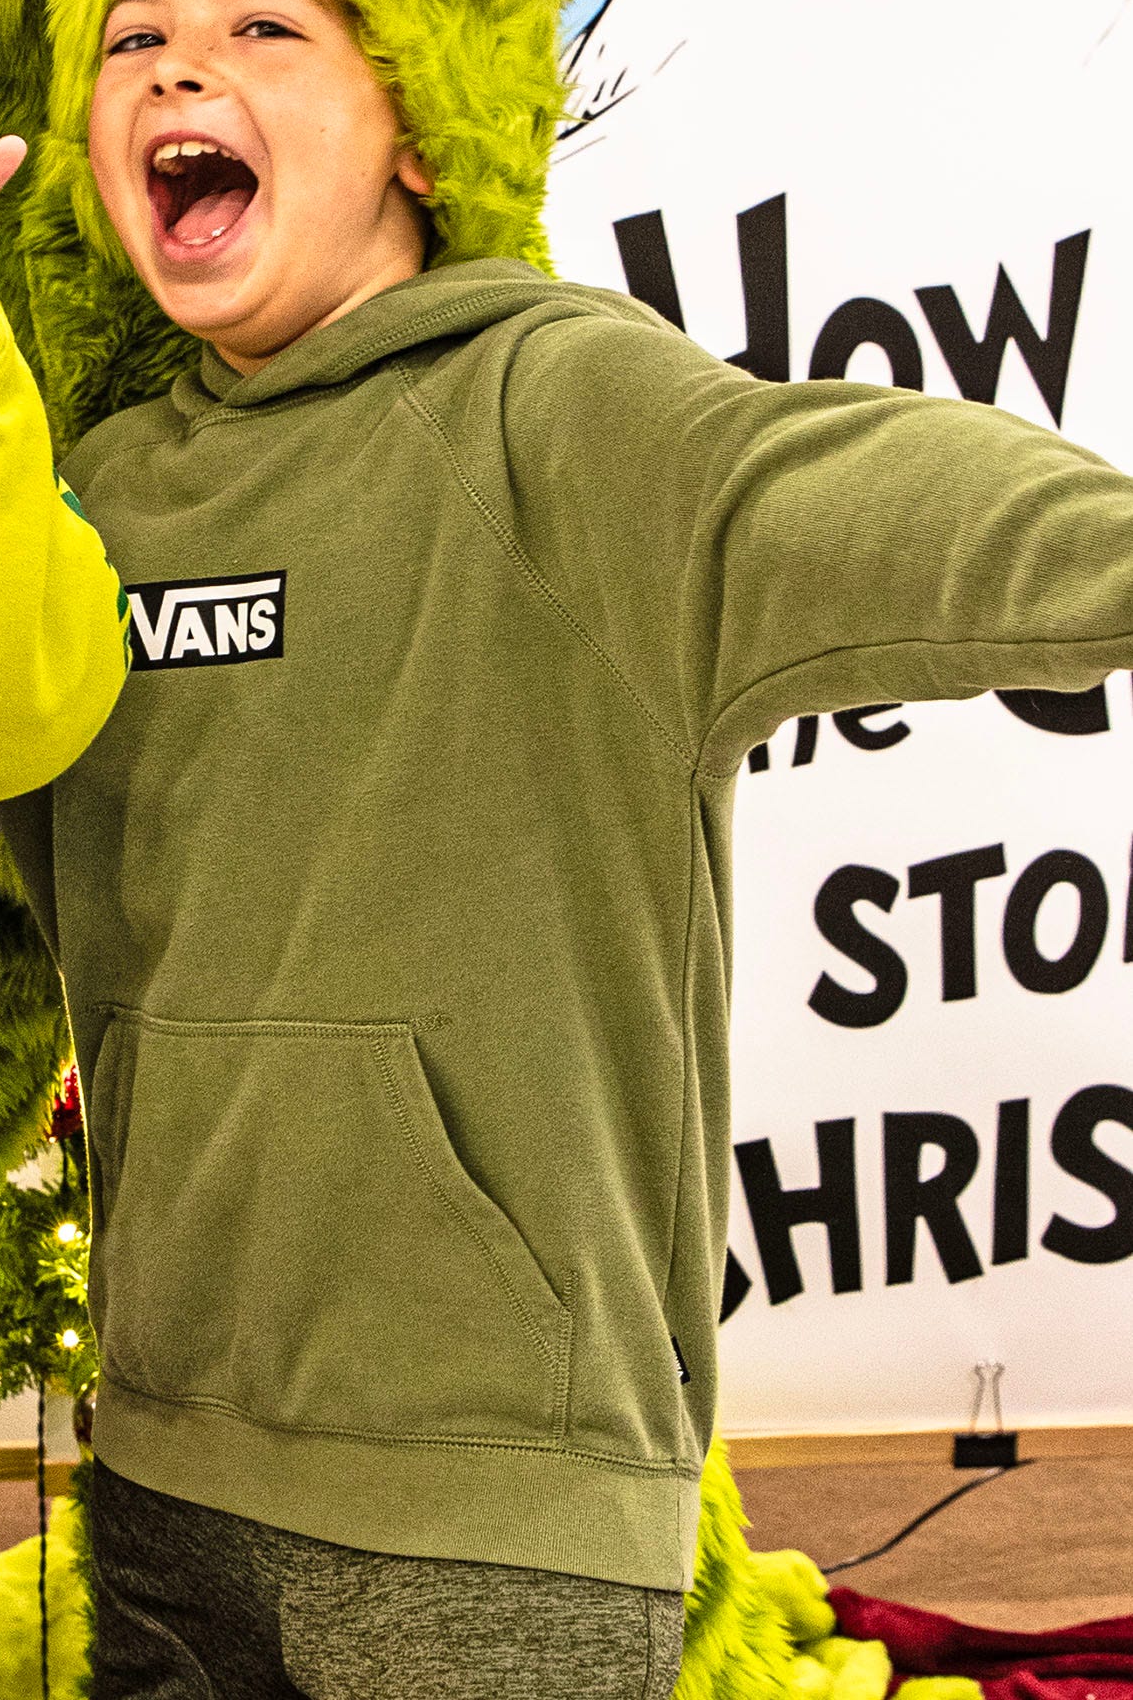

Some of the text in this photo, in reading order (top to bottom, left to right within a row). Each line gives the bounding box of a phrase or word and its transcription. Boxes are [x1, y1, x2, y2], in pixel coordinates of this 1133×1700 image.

[128, 578, 281, 661] VANS
[808, 833, 1133, 1029] STO
[718, 1083, 1133, 1325] HRIS
